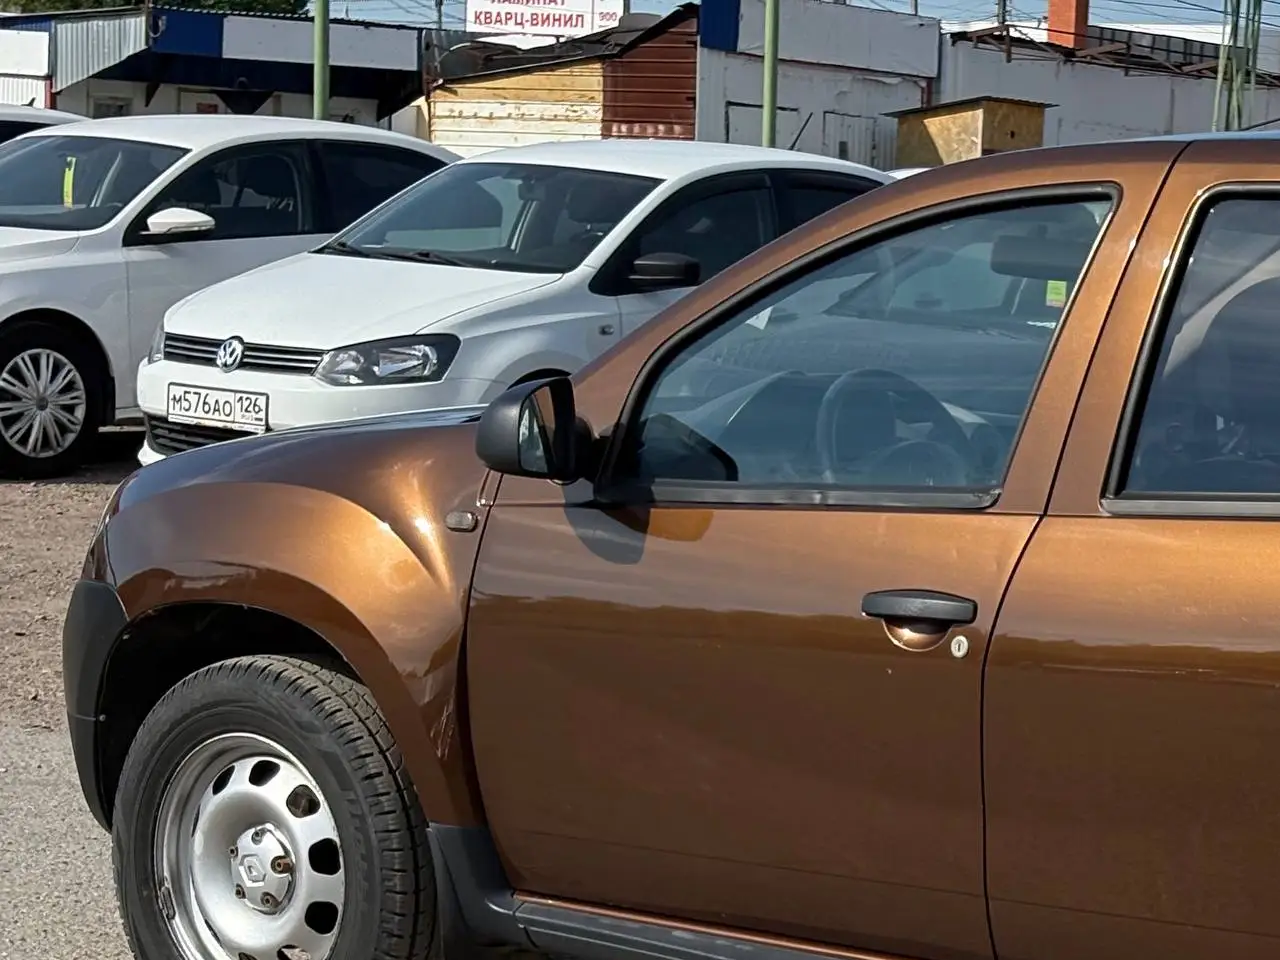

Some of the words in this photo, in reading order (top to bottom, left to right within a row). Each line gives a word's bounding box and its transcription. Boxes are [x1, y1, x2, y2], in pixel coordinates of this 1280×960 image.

[474, 11, 584, 29] КВАРЦ-ВИНИЛ
[172, 390, 233, 417] М576АО
[237, 396, 262, 414] 126
